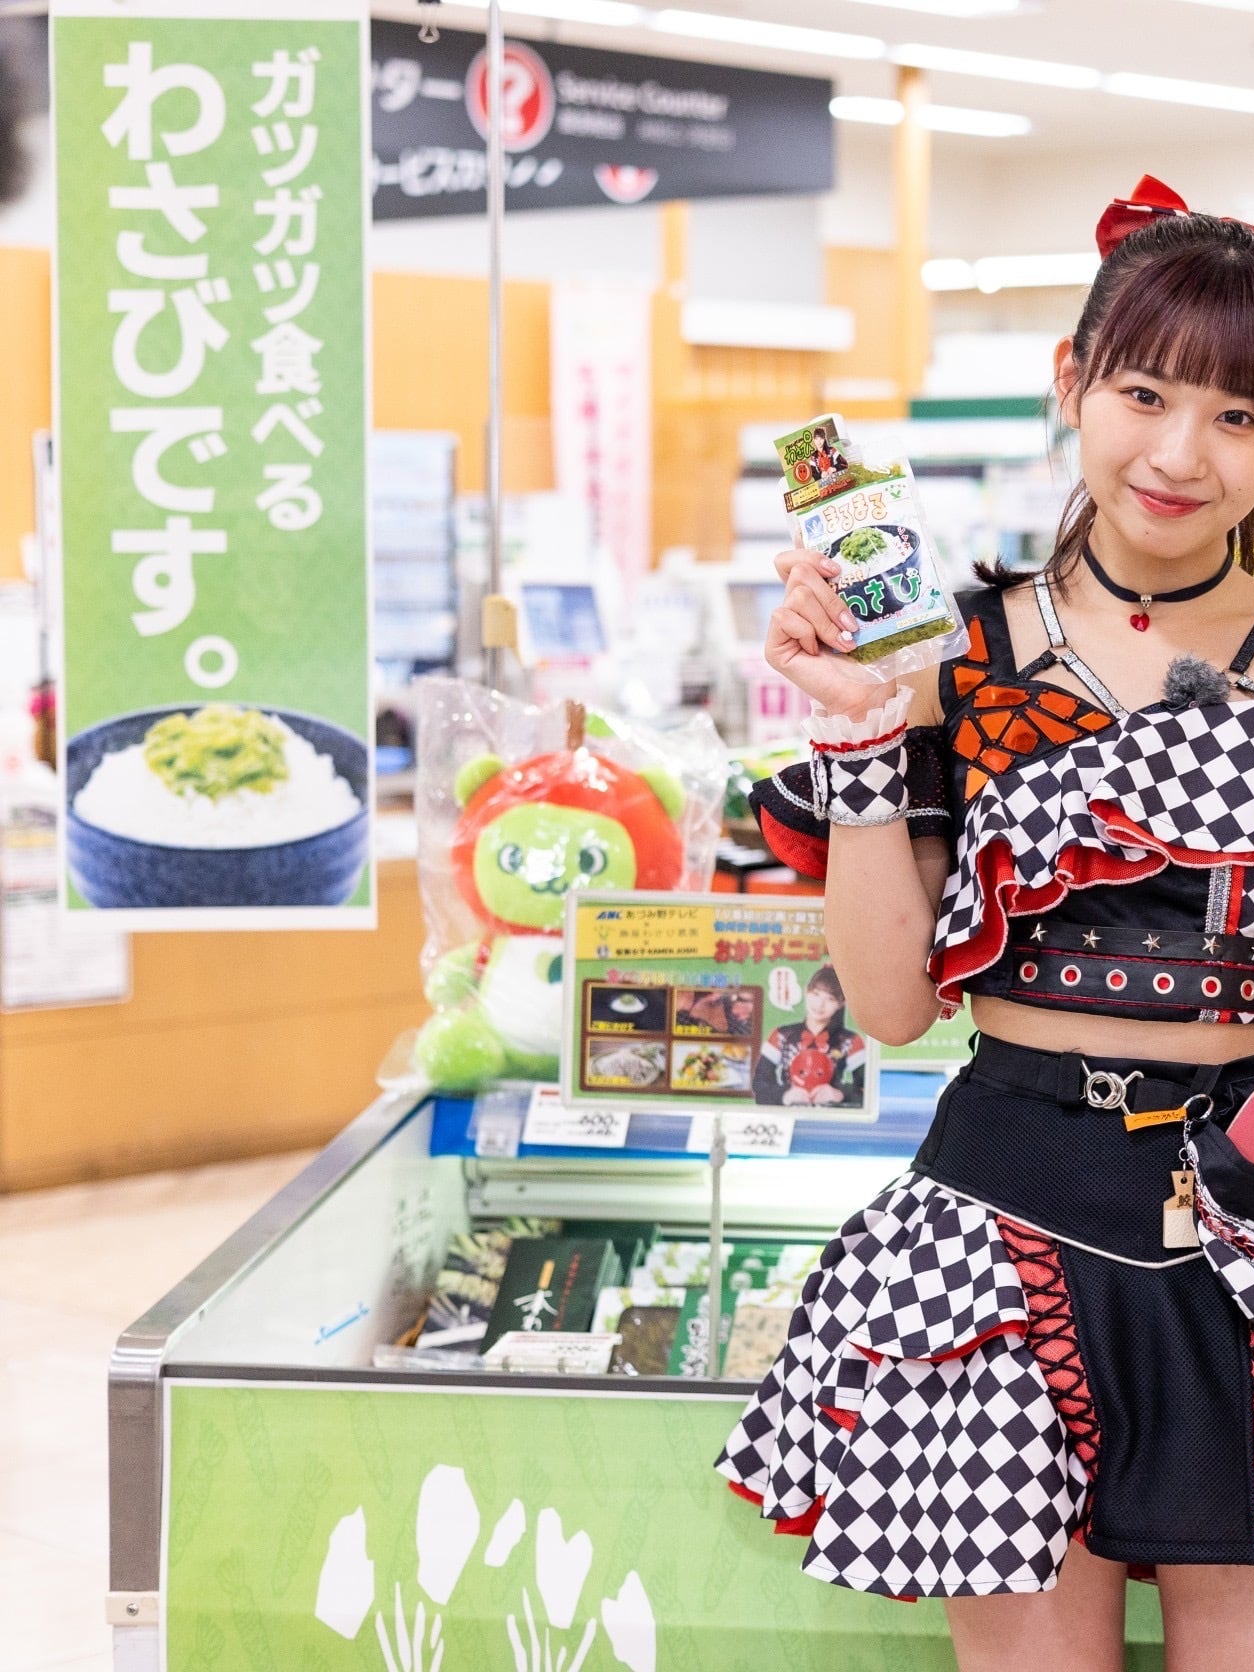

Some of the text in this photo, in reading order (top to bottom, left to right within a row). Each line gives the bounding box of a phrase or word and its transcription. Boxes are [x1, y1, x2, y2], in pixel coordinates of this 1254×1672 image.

[101, 42, 239, 688] わさびです。
[251, 46, 324, 532] ガツガツ食べる
[824, 491, 888, 533] まるまる
